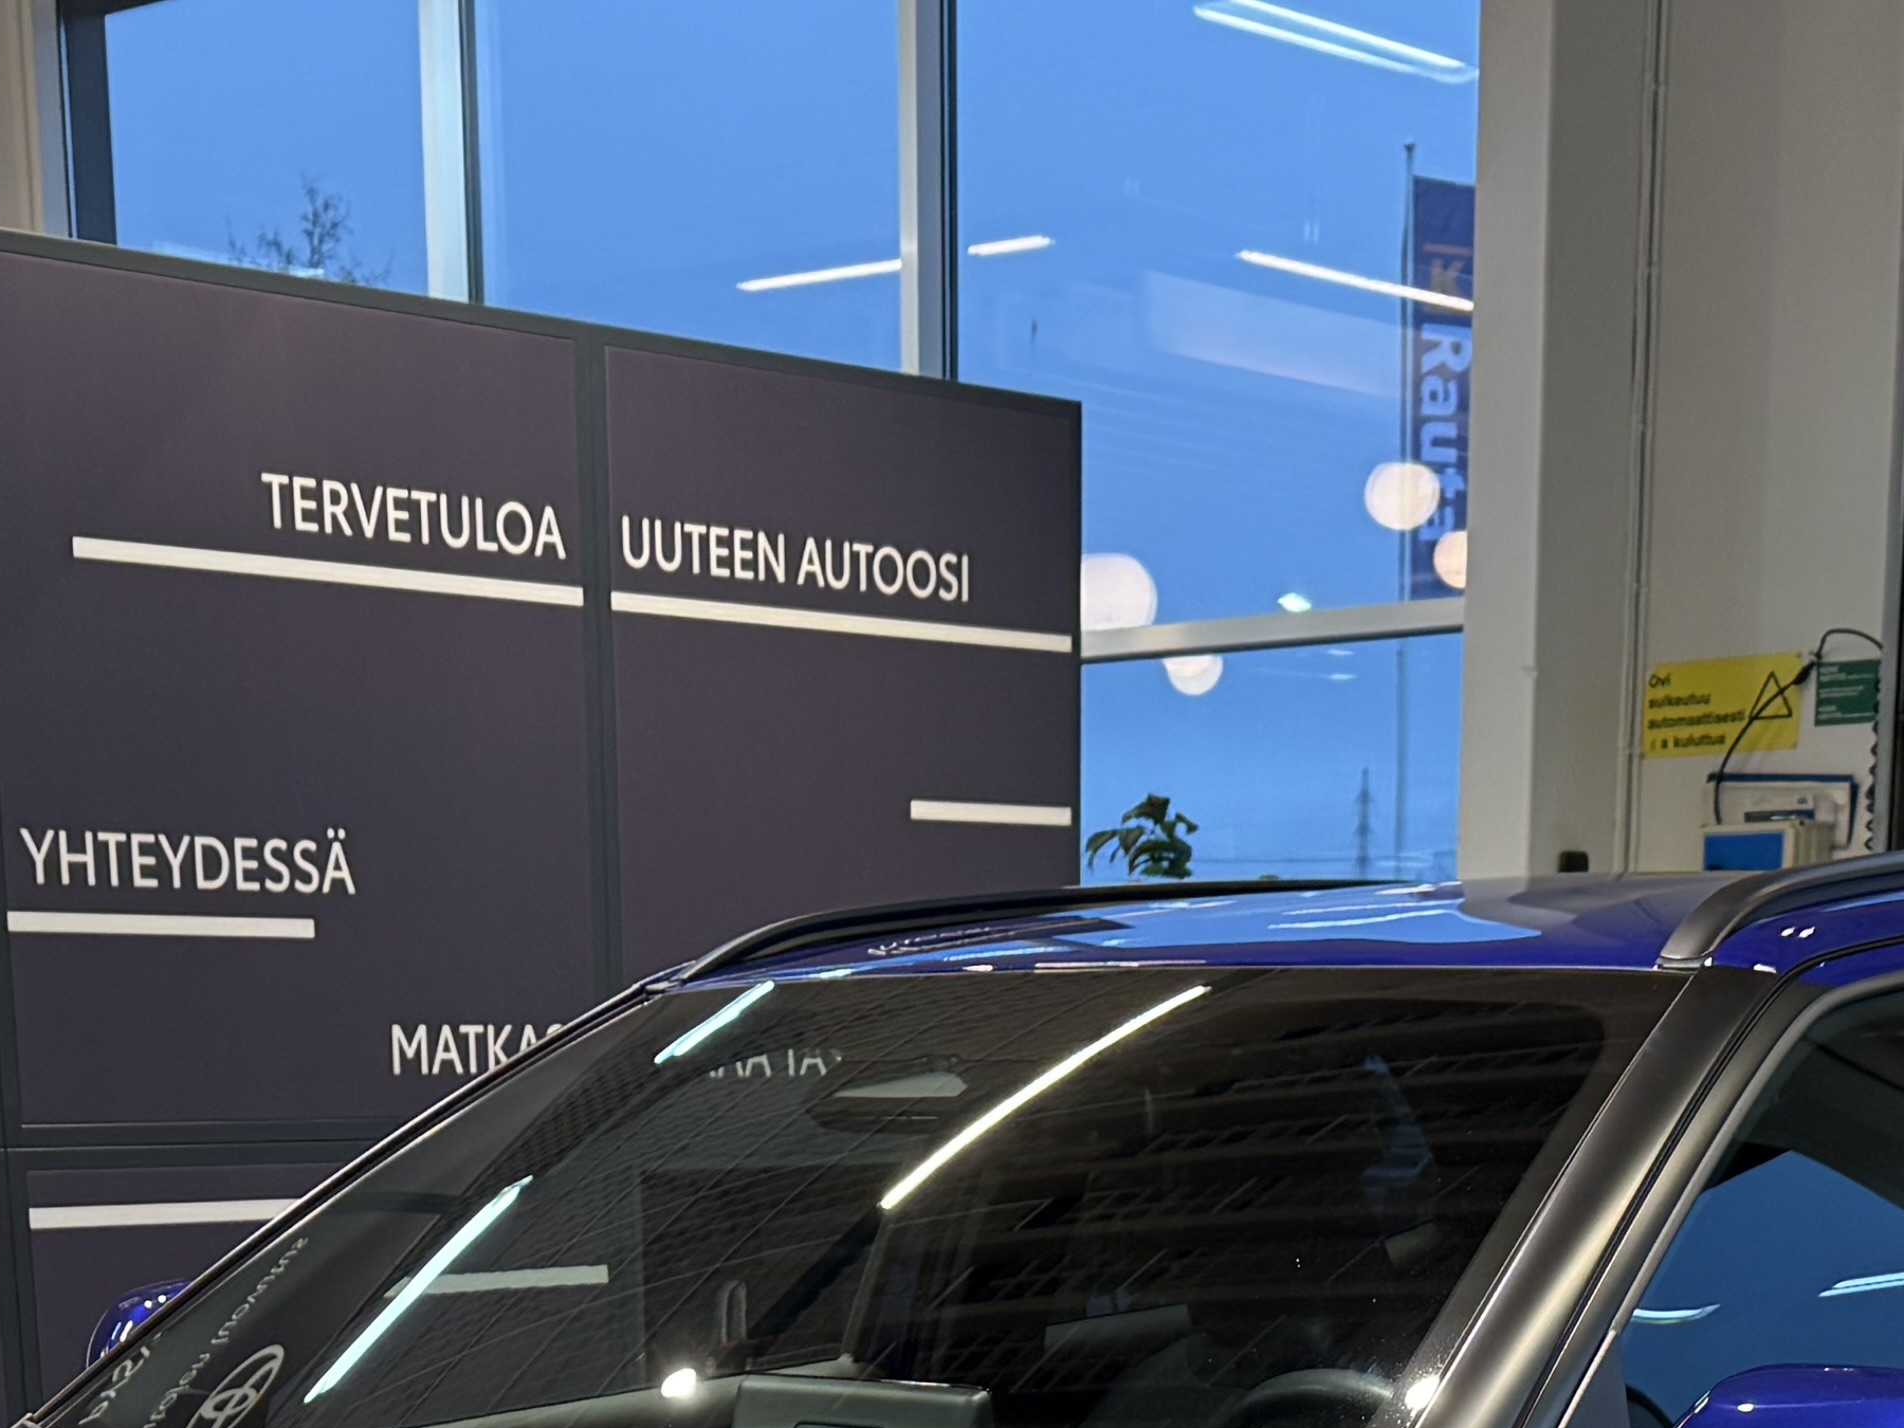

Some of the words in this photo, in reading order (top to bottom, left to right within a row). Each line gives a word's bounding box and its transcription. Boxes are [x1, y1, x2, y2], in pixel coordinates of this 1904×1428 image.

[260, 472, 568, 560] TERVETULOA
[621, 514, 786, 584] UUTEEN
[796, 536, 970, 602] AUTOOSI
[1648, 672, 1671, 689] Ovi
[19, 827, 356, 895] YHTEYDESSÄ
